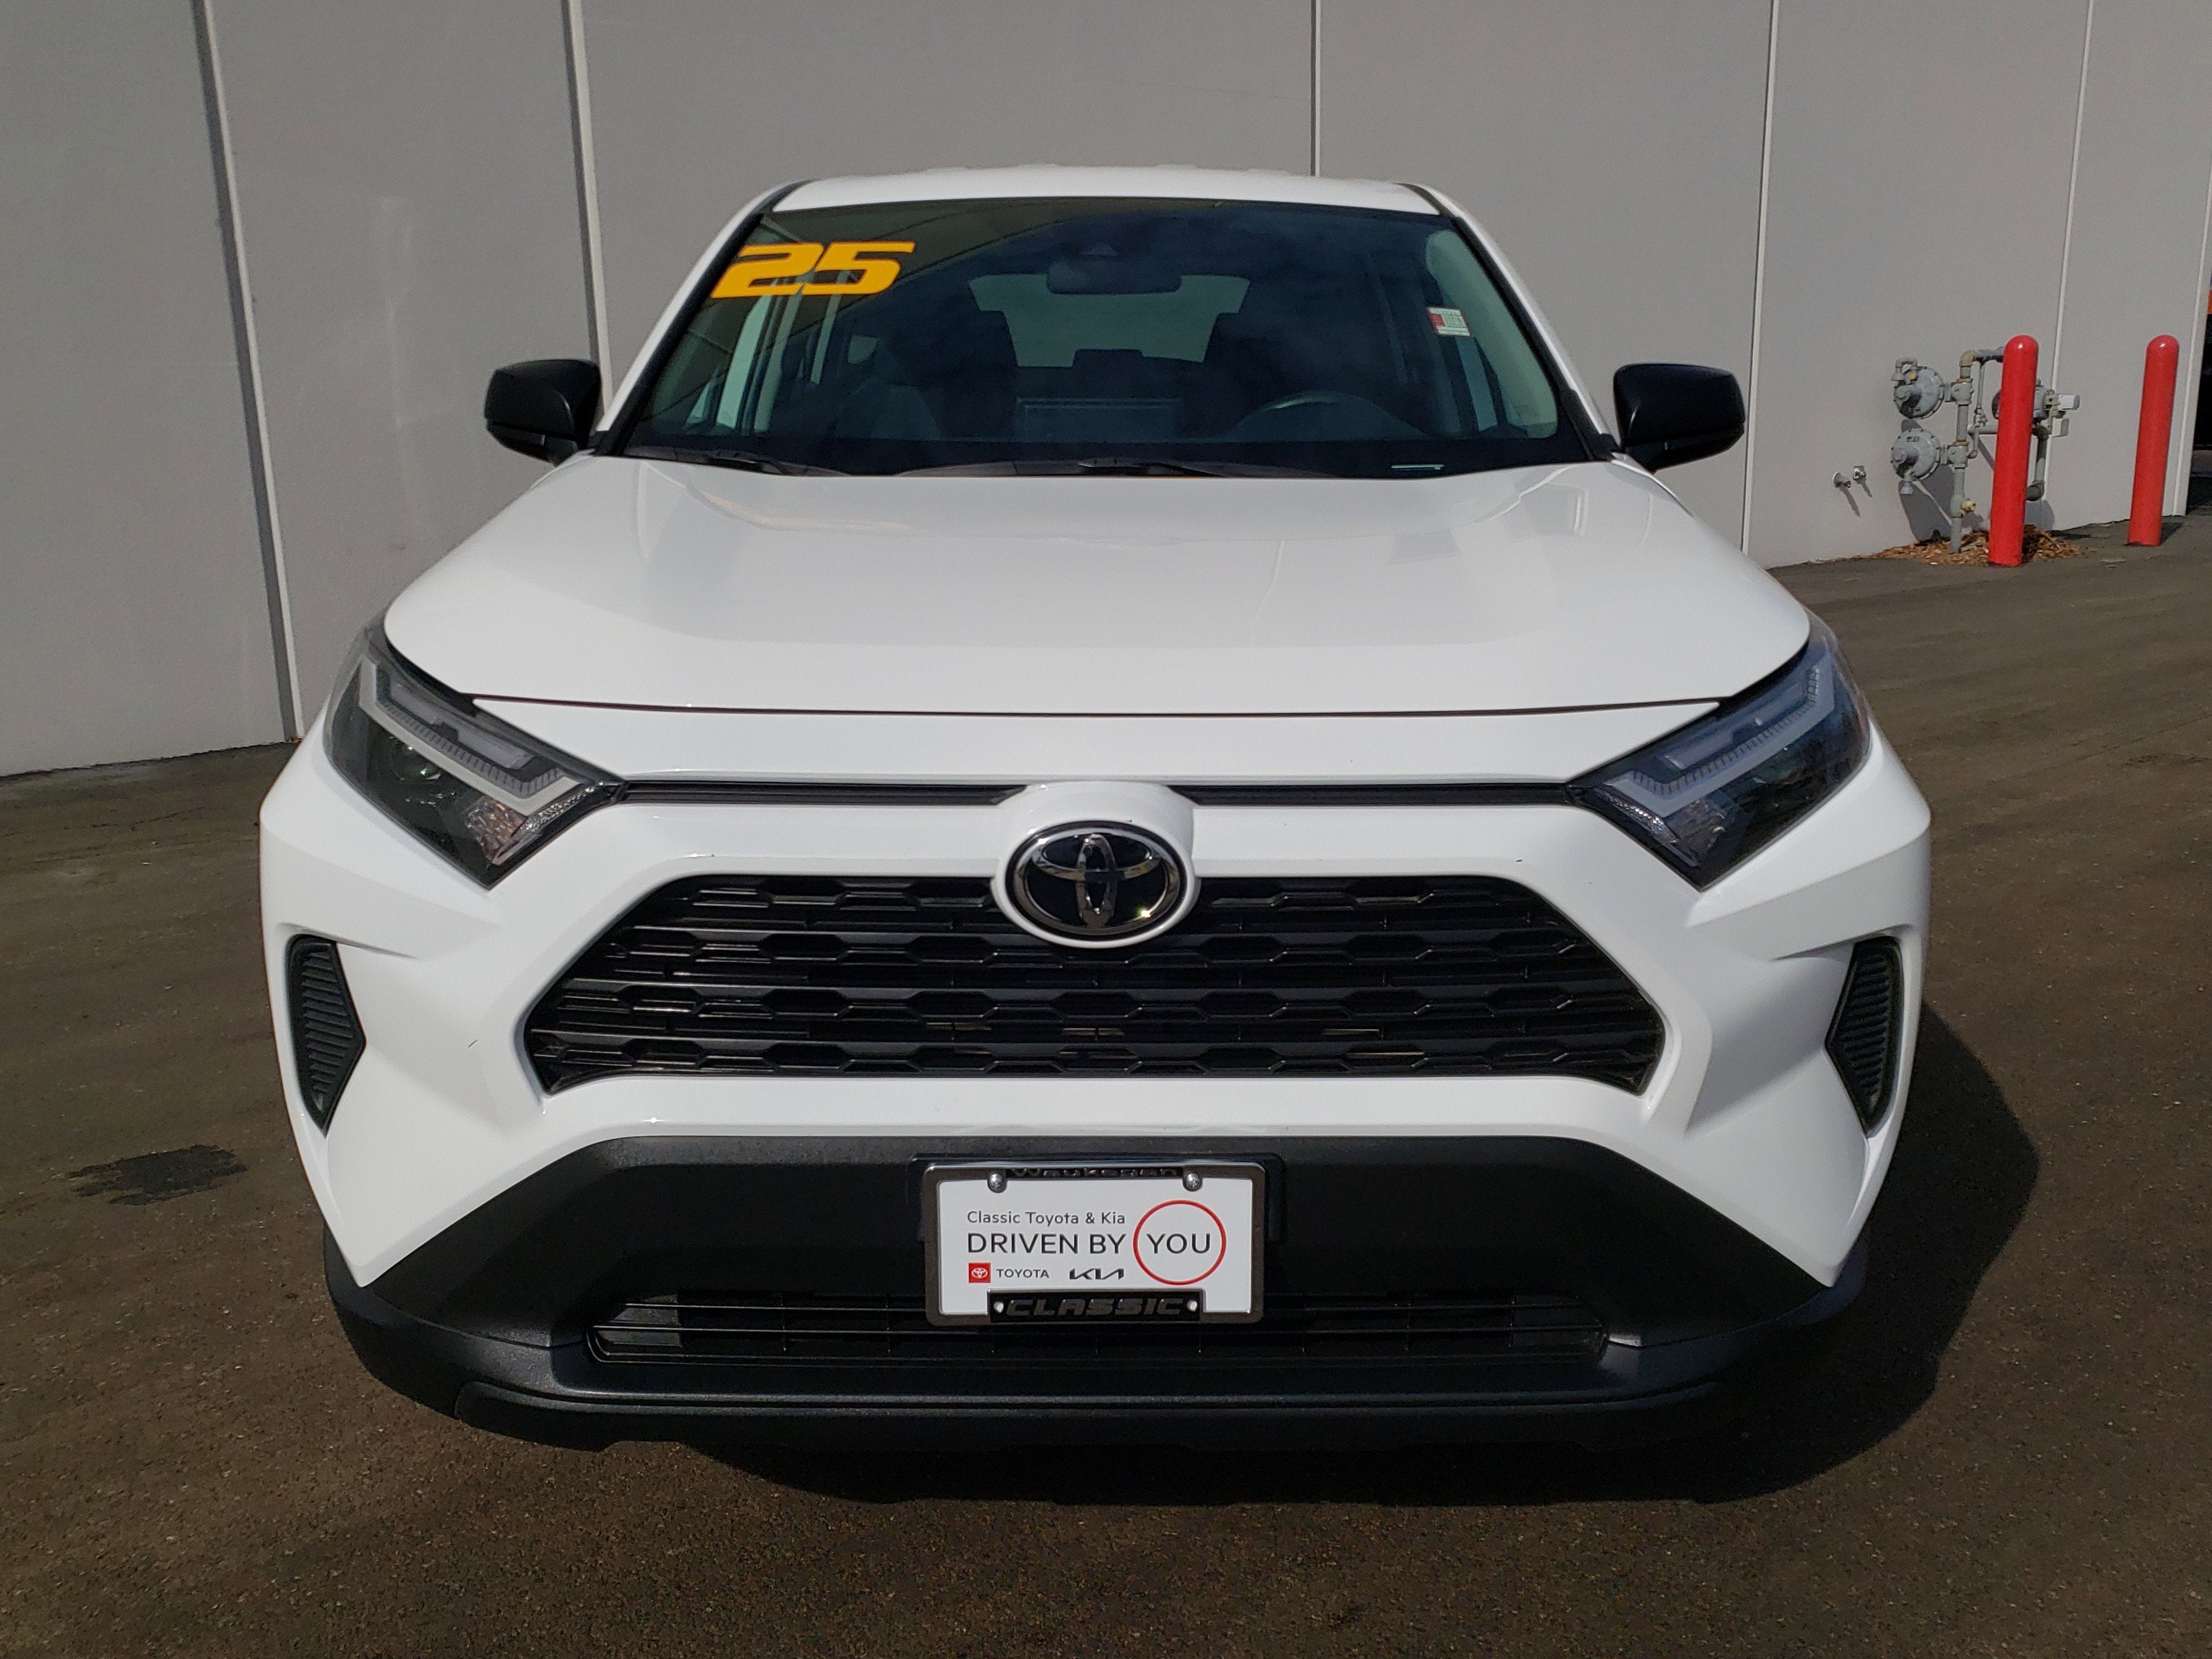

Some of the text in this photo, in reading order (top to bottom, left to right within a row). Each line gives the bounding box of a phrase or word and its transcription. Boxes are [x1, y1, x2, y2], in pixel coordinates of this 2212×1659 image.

[711, 241, 915, 298] 25
[967, 1211, 1125, 1227] Classic Toyota & Kia
[968, 1233, 1210, 1254] DRIVEN BY YOU
[996, 1268, 1049, 1278] TOYOTA
[1007, 1299, 1182, 1315] CLASSIC
